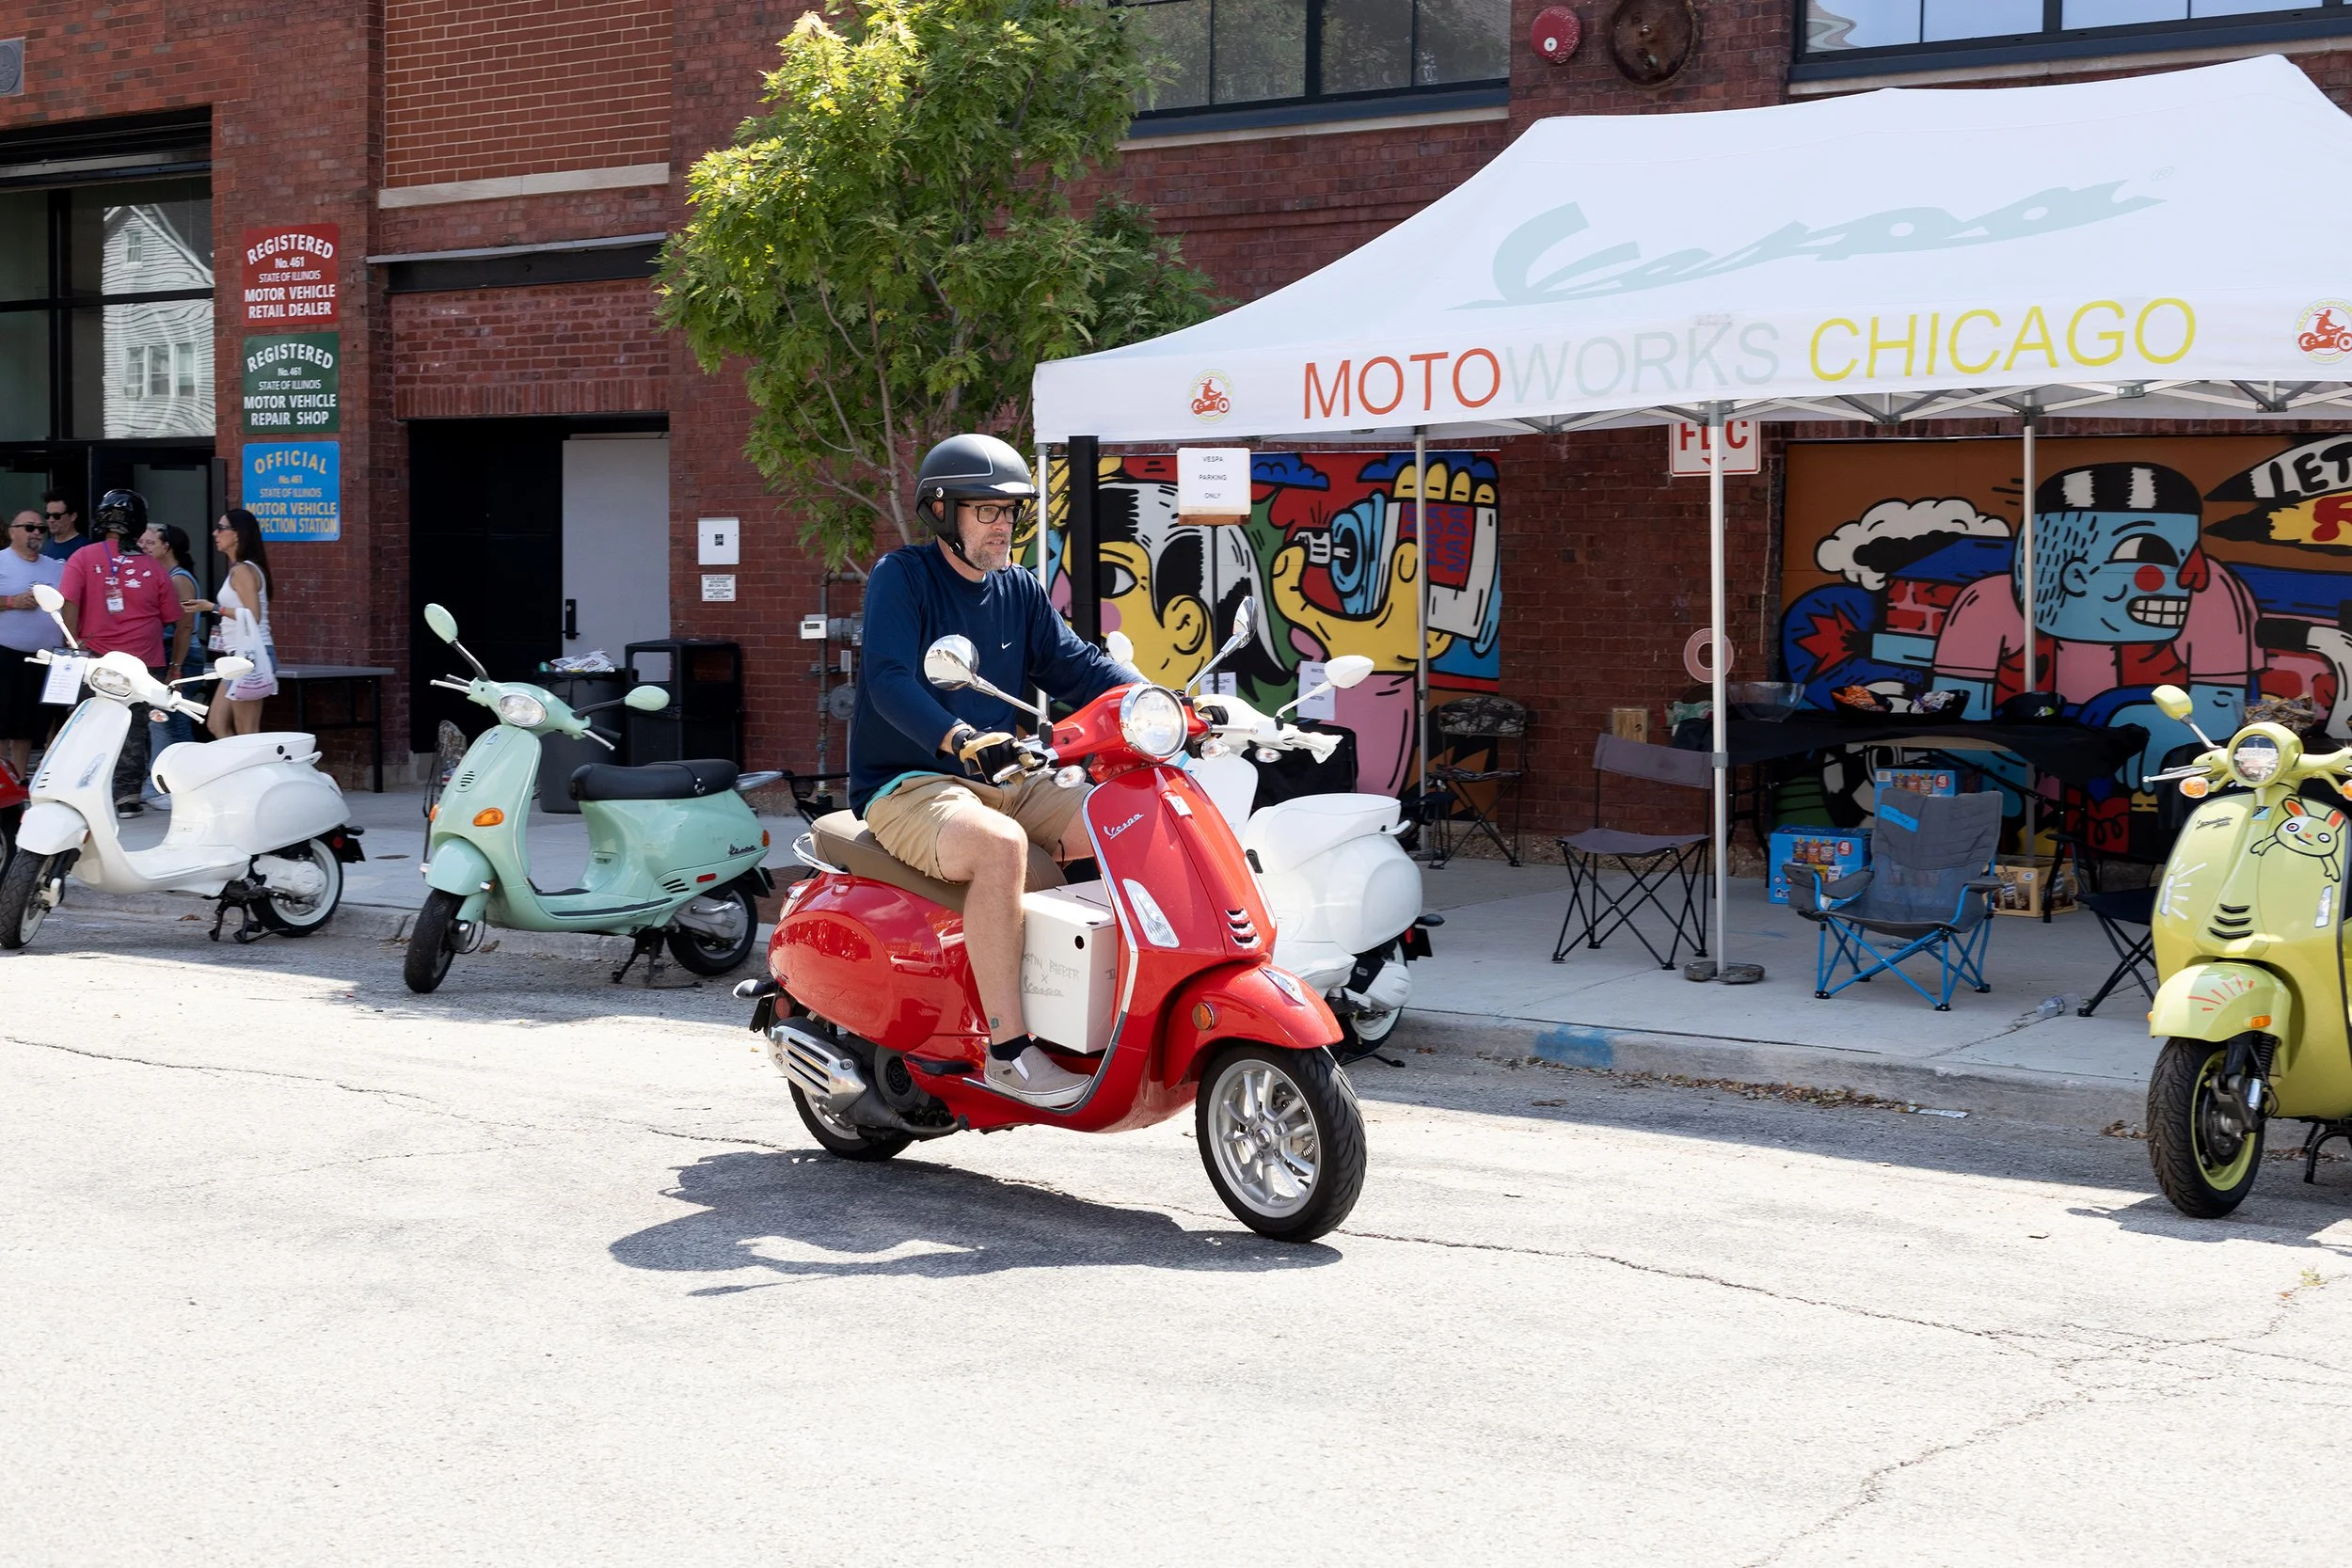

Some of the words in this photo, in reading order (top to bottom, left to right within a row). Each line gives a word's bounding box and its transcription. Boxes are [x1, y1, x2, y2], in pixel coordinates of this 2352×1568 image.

[246, 234, 334, 265] REGISTERED
[1442, 179, 2169, 311] Vespa
[290, 256, 305, 268] 461
[258, 273, 280, 283] STATE
[280, 272, 292, 282] OF
[292, 270, 322, 281] ILLINOIS
[245, 287, 286, 302] MOTOR
[289, 284, 336, 300] VEHICLE
[248, 304, 286, 319] RETAIL
[288, 301, 332, 317] DEALER
[1809, 297, 2197, 382] CHICAGO
[246, 343, 334, 373] REGISTERED
[258, 381, 280, 391] STATE
[280, 380, 292, 390] OF
[292, 379, 322, 390] ILLINOIS
[244, 395, 286, 410] MOTOR
[289, 393, 337, 408] VEHICLE
[250, 412, 292, 426] REPAIR
[296, 411, 329, 425] SHOP
[254, 450, 326, 475] OFFICIAL
[259, 488, 281, 499] STATE
[281, 488, 293, 499] OF
[293, 487, 323, 498] ILLINOIS
[246, 502, 288, 515] MOTOR
[290, 502, 337, 515] VEHICLE
[257, 517, 297, 534] PECTION
[298, 517, 337, 534] STATION
[1446, 508, 1469, 573] NADA
[1104, 814, 1144, 840] Vespa
[1049, 959, 1080, 980] BIEBER
[1024, 974, 1064, 997] Vespa
